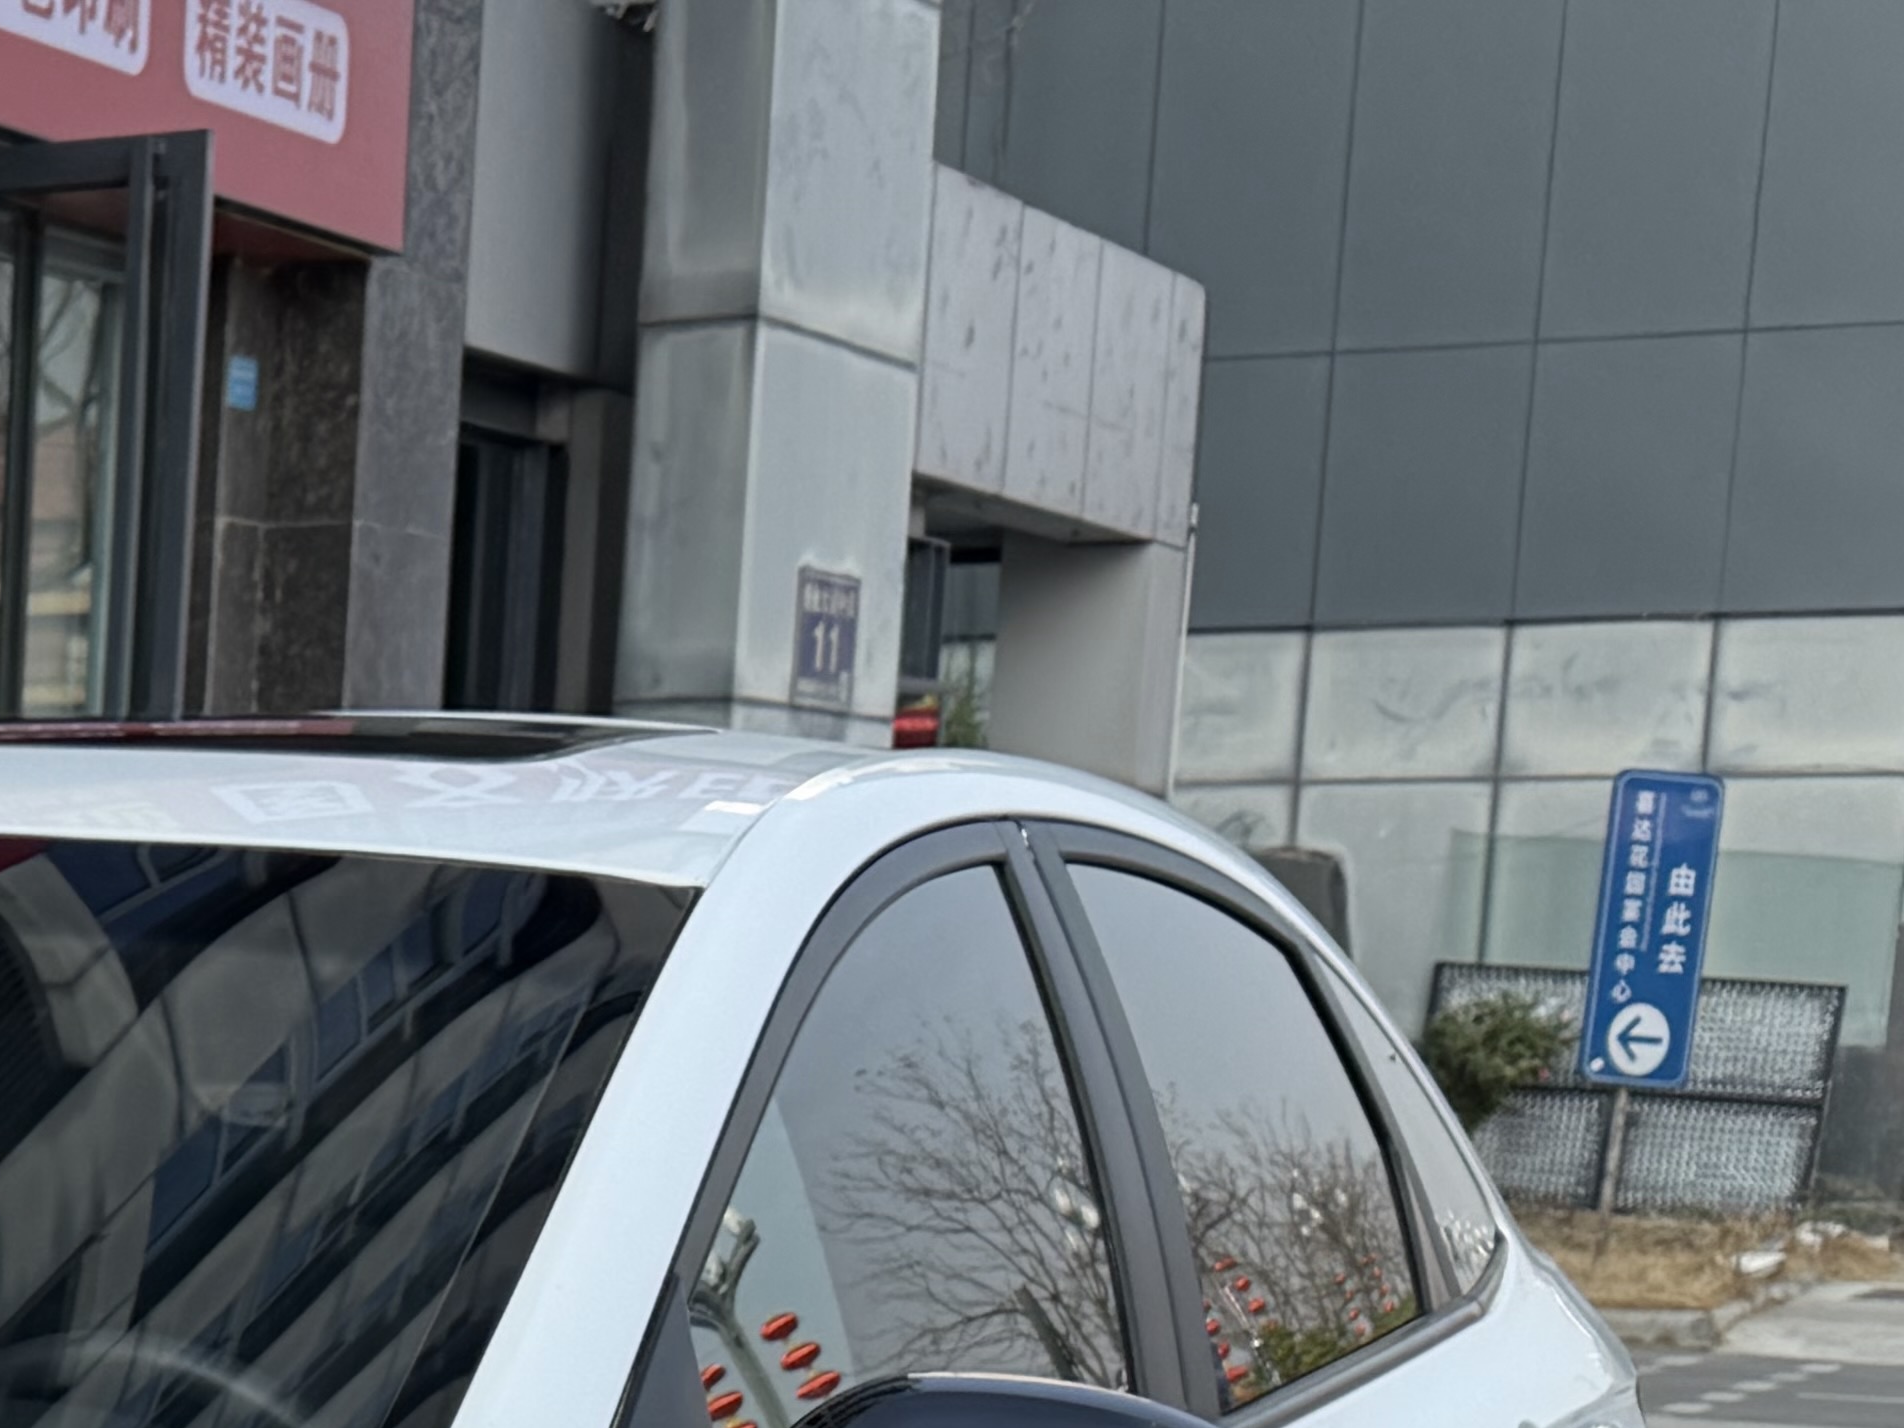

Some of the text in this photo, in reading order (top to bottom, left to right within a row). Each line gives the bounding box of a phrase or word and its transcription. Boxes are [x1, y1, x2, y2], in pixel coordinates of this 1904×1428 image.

[196, 0, 342, 122] 精装画册
[813, 620, 840, 674] 11
[1657, 862, 1698, 975] 由此去
